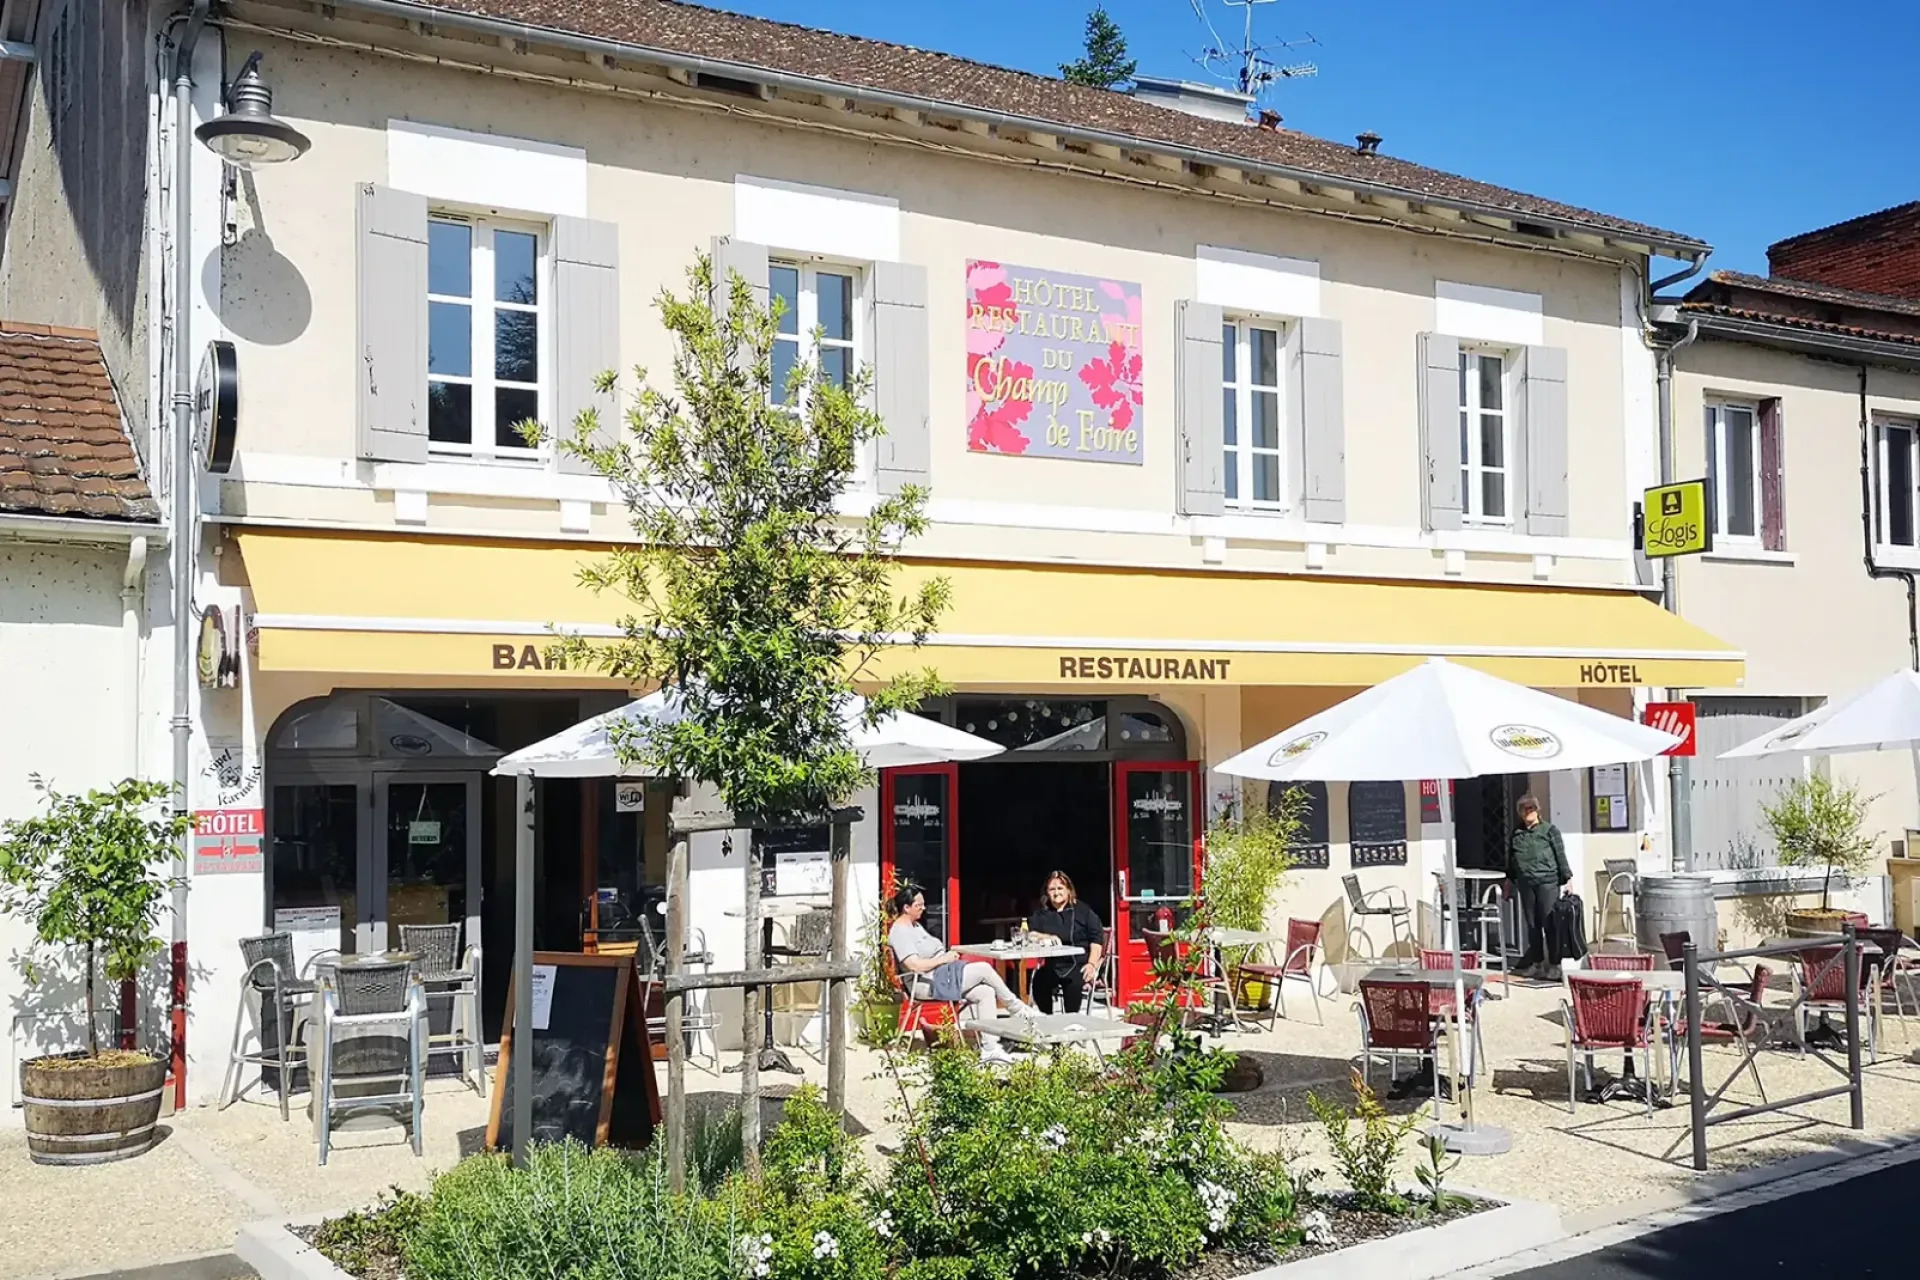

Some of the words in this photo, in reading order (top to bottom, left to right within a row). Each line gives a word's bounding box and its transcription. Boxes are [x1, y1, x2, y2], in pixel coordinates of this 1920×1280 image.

[1013, 277, 1100, 313] HÔTEL
[971, 303, 1139, 349] RESTAURANT
[1042, 348, 1074, 371] DU
[974, 355, 1070, 417] Champ
[1046, 414, 1071, 448] de
[1075, 409, 1138, 454] Foire
[1647, 517, 1698, 549] Logis
[1059, 656, 1231, 680] RESTAURANT
[1580, 661, 1642, 683] HÔTEL
[200, 748, 232, 778] Tripel
[199, 808, 258, 834] HÔTEL
